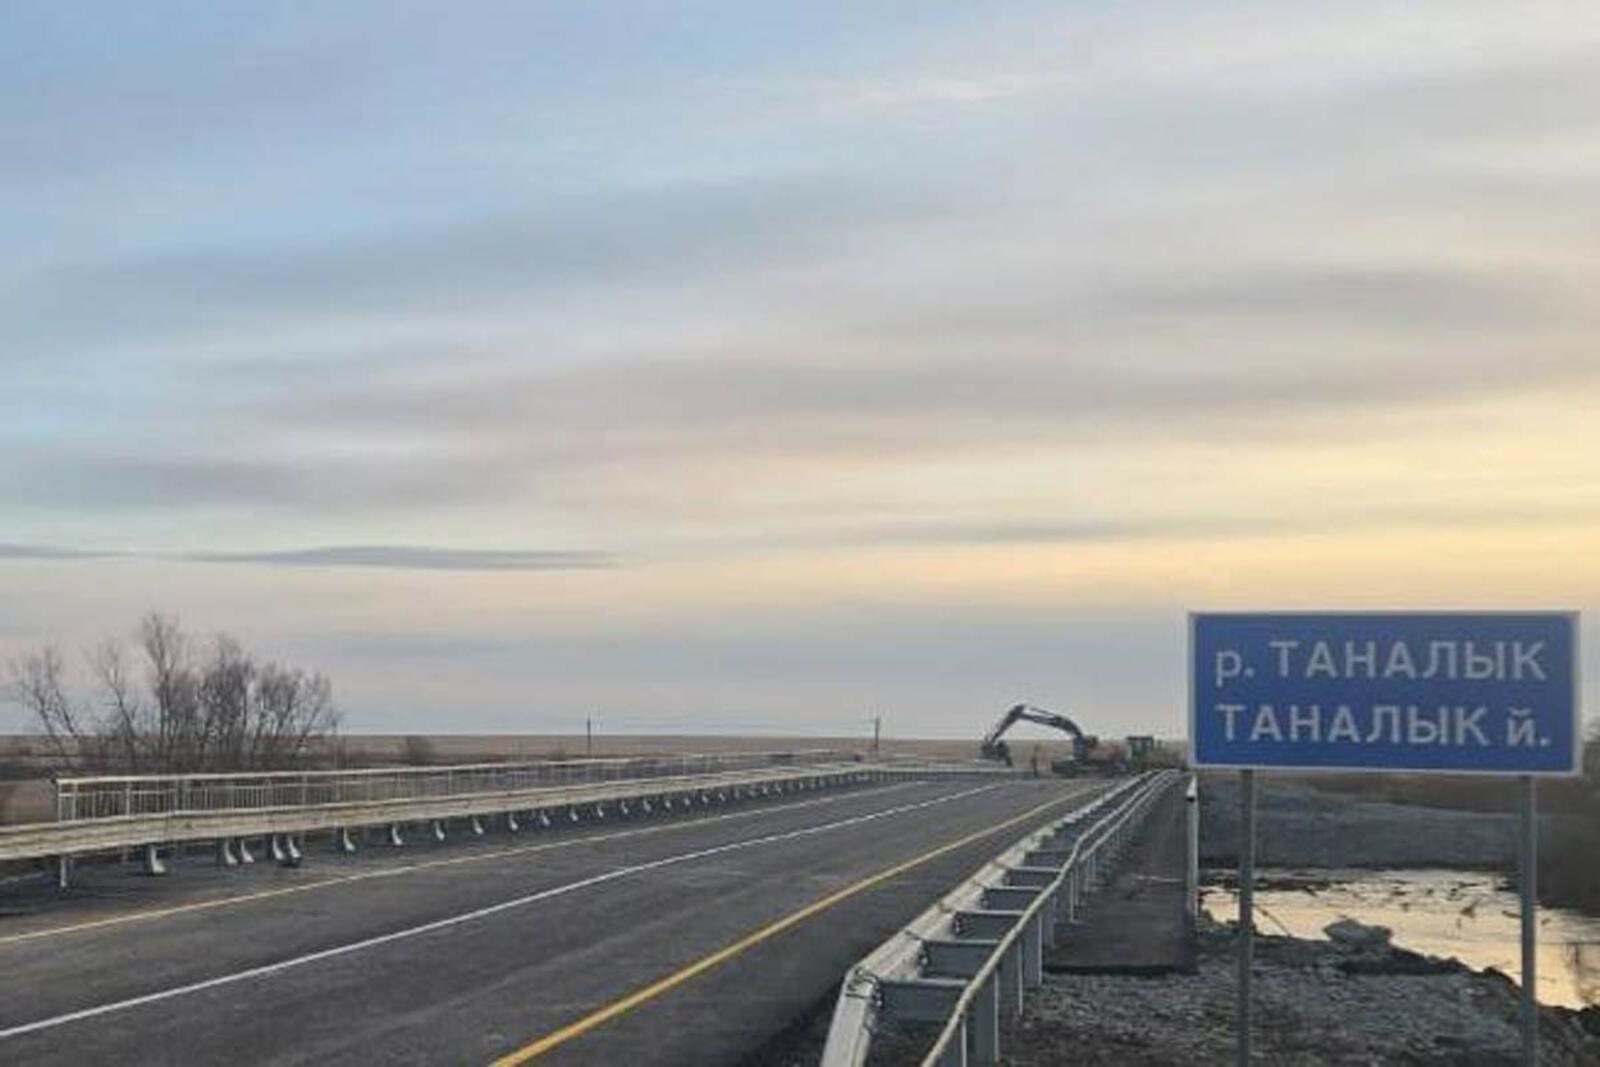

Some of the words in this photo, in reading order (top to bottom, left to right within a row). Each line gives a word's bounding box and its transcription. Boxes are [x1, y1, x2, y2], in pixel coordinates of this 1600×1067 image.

[1215, 649, 1255, 687] р.
[1268, 640, 1546, 681] ТАНАЛЫК
[1215, 703, 1489, 746] ТАНАЛЫК
[1506, 707, 1551, 747] й.
